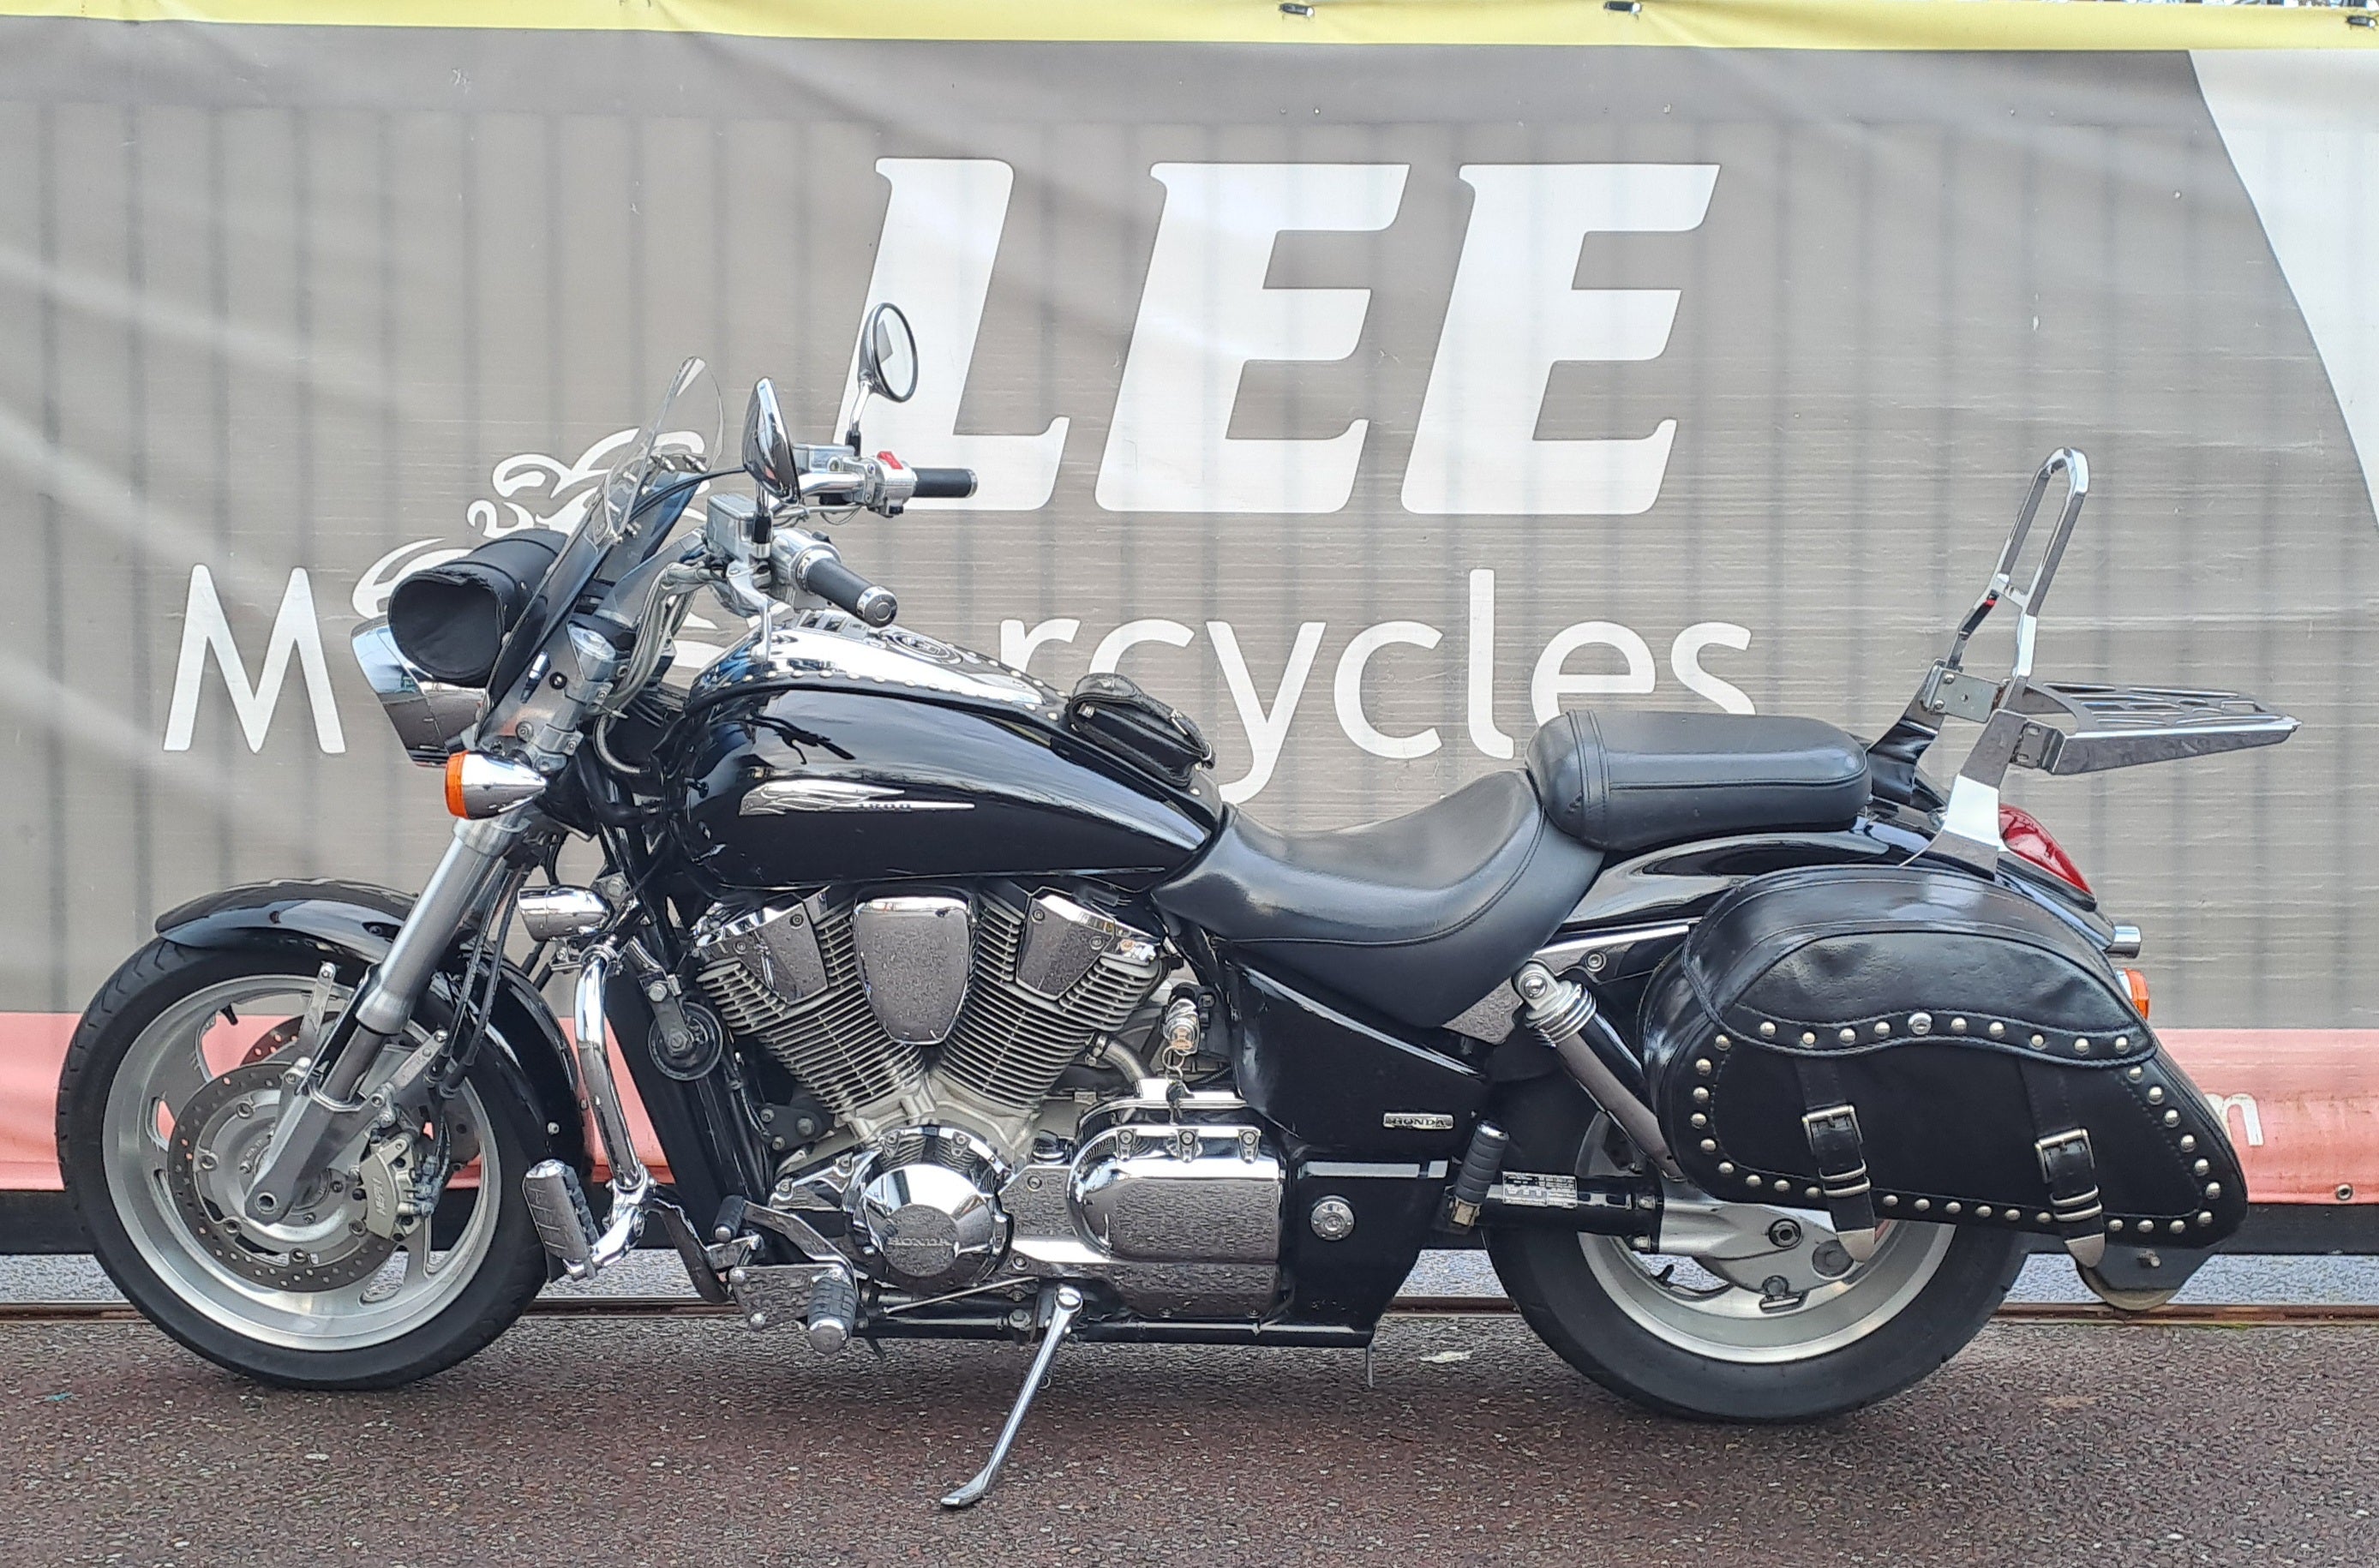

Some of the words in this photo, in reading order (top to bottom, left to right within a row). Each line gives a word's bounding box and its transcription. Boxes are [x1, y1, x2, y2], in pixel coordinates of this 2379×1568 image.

[833, 158, 1720, 514] LEE
[1392, 1116, 1446, 1127] HONDA
[887, 1237, 952, 1247] HONDA
